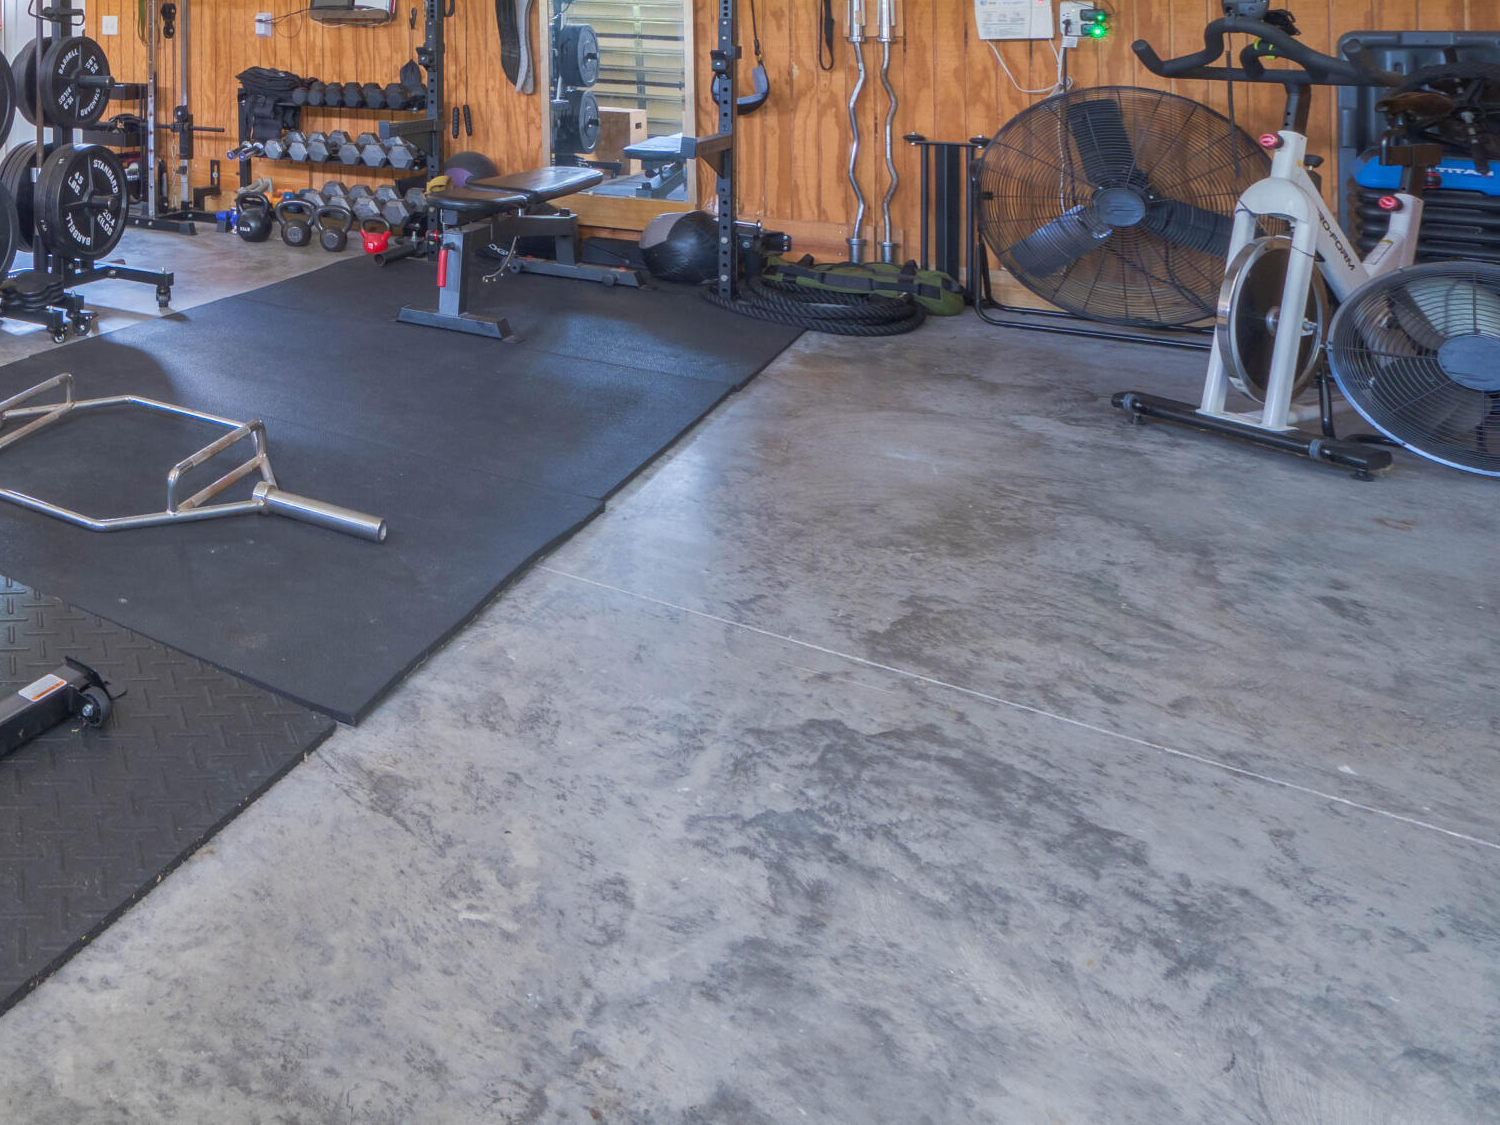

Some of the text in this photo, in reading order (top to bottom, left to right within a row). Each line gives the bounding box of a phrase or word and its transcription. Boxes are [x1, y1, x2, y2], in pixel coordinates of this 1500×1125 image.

[58, 48, 80, 74] BARBELL
[80, 88, 101, 117] STANDARD
[74, 171, 84, 185] 45
[93, 159, 119, 194] STANDARD
[65, 212, 91, 246] BARBELL
[97, 213, 113, 236] KILOS
